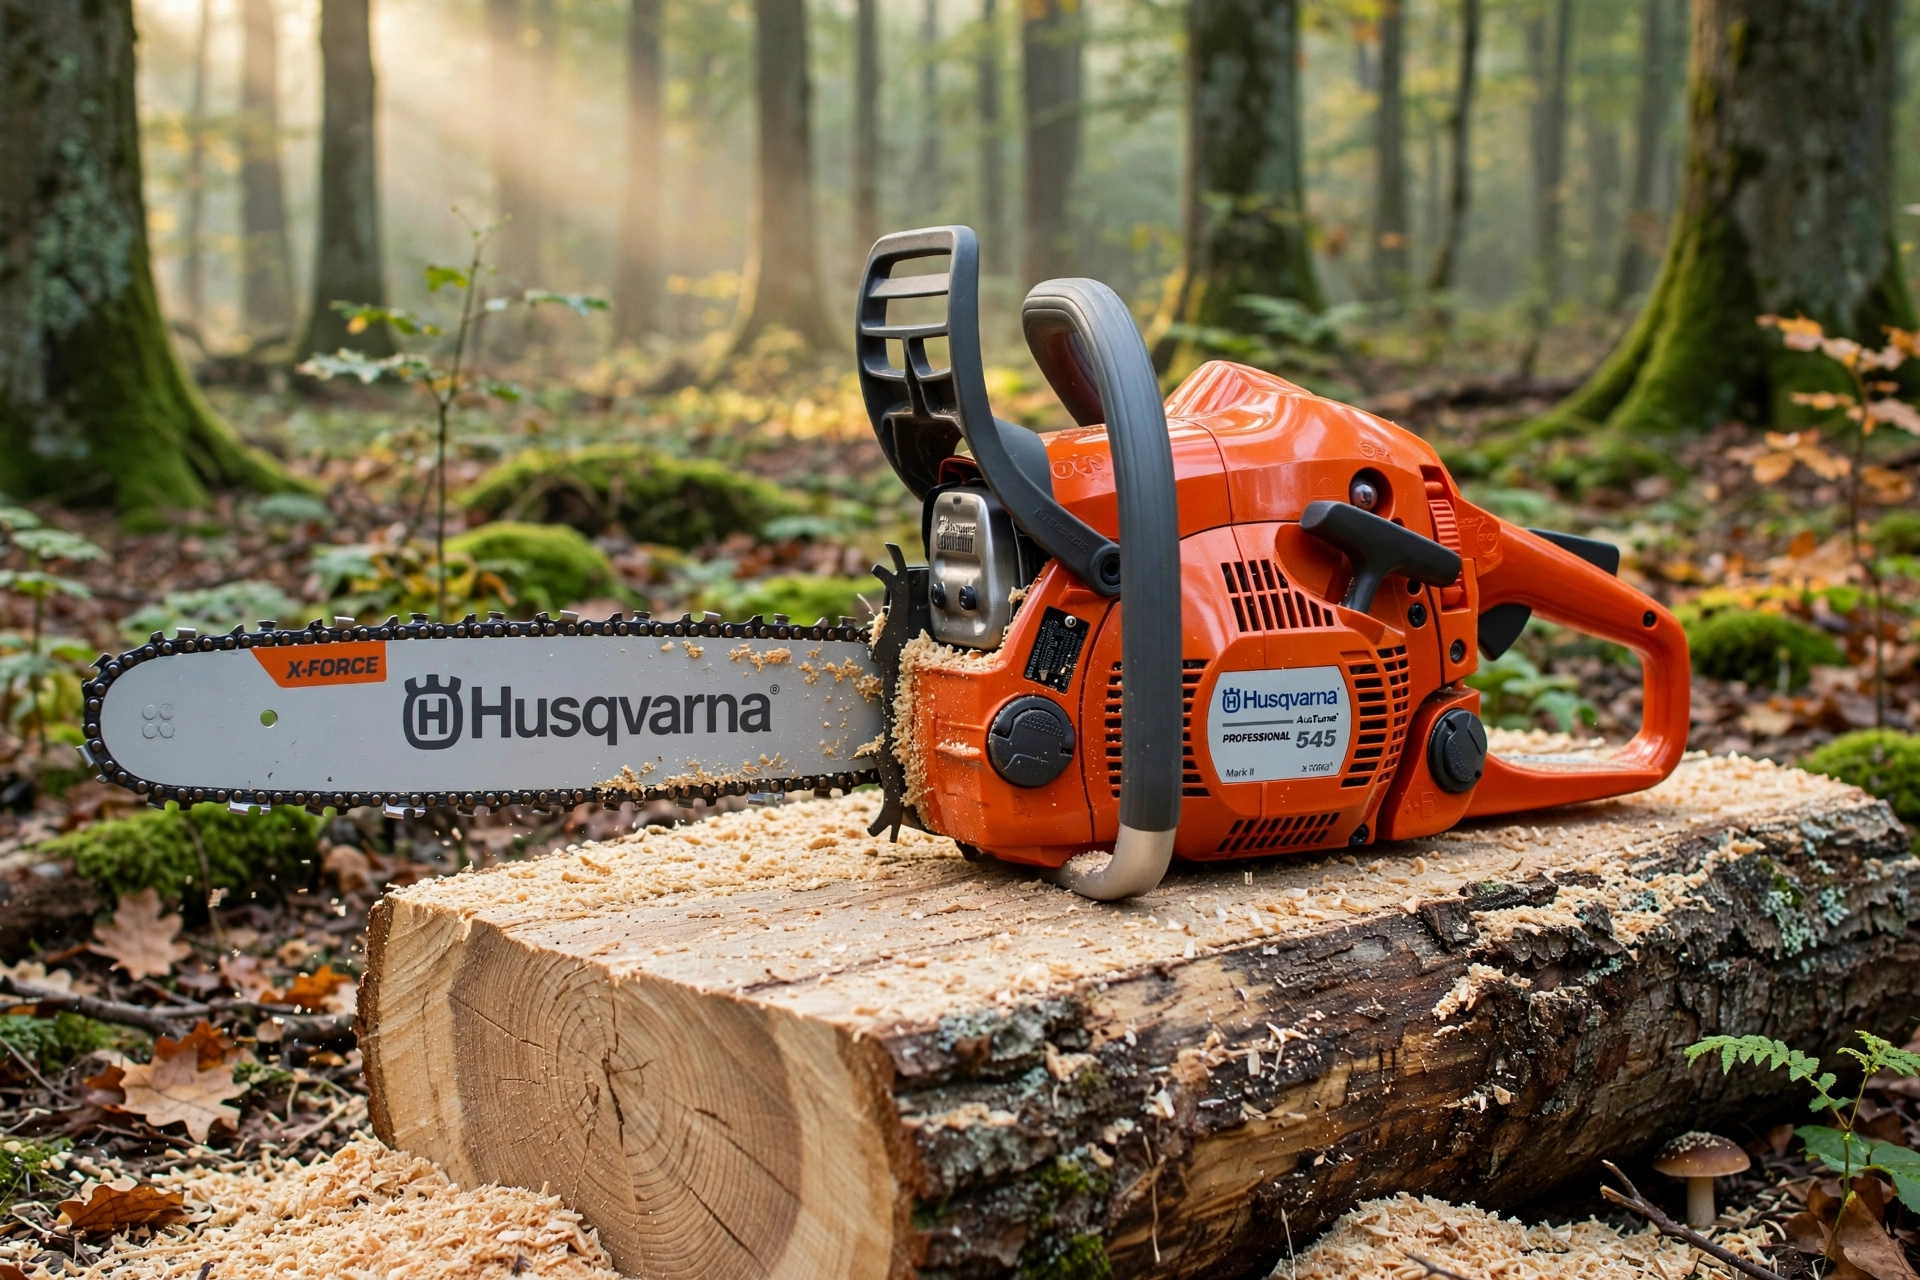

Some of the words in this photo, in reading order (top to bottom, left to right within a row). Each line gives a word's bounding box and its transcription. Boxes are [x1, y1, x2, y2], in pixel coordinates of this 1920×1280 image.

[285, 656, 380, 679] X-FORCE
[1222, 731, 1291, 743] PROFESSIONAL
[1296, 729, 1337, 749] 545
[1225, 768, 1248, 777] Mark
